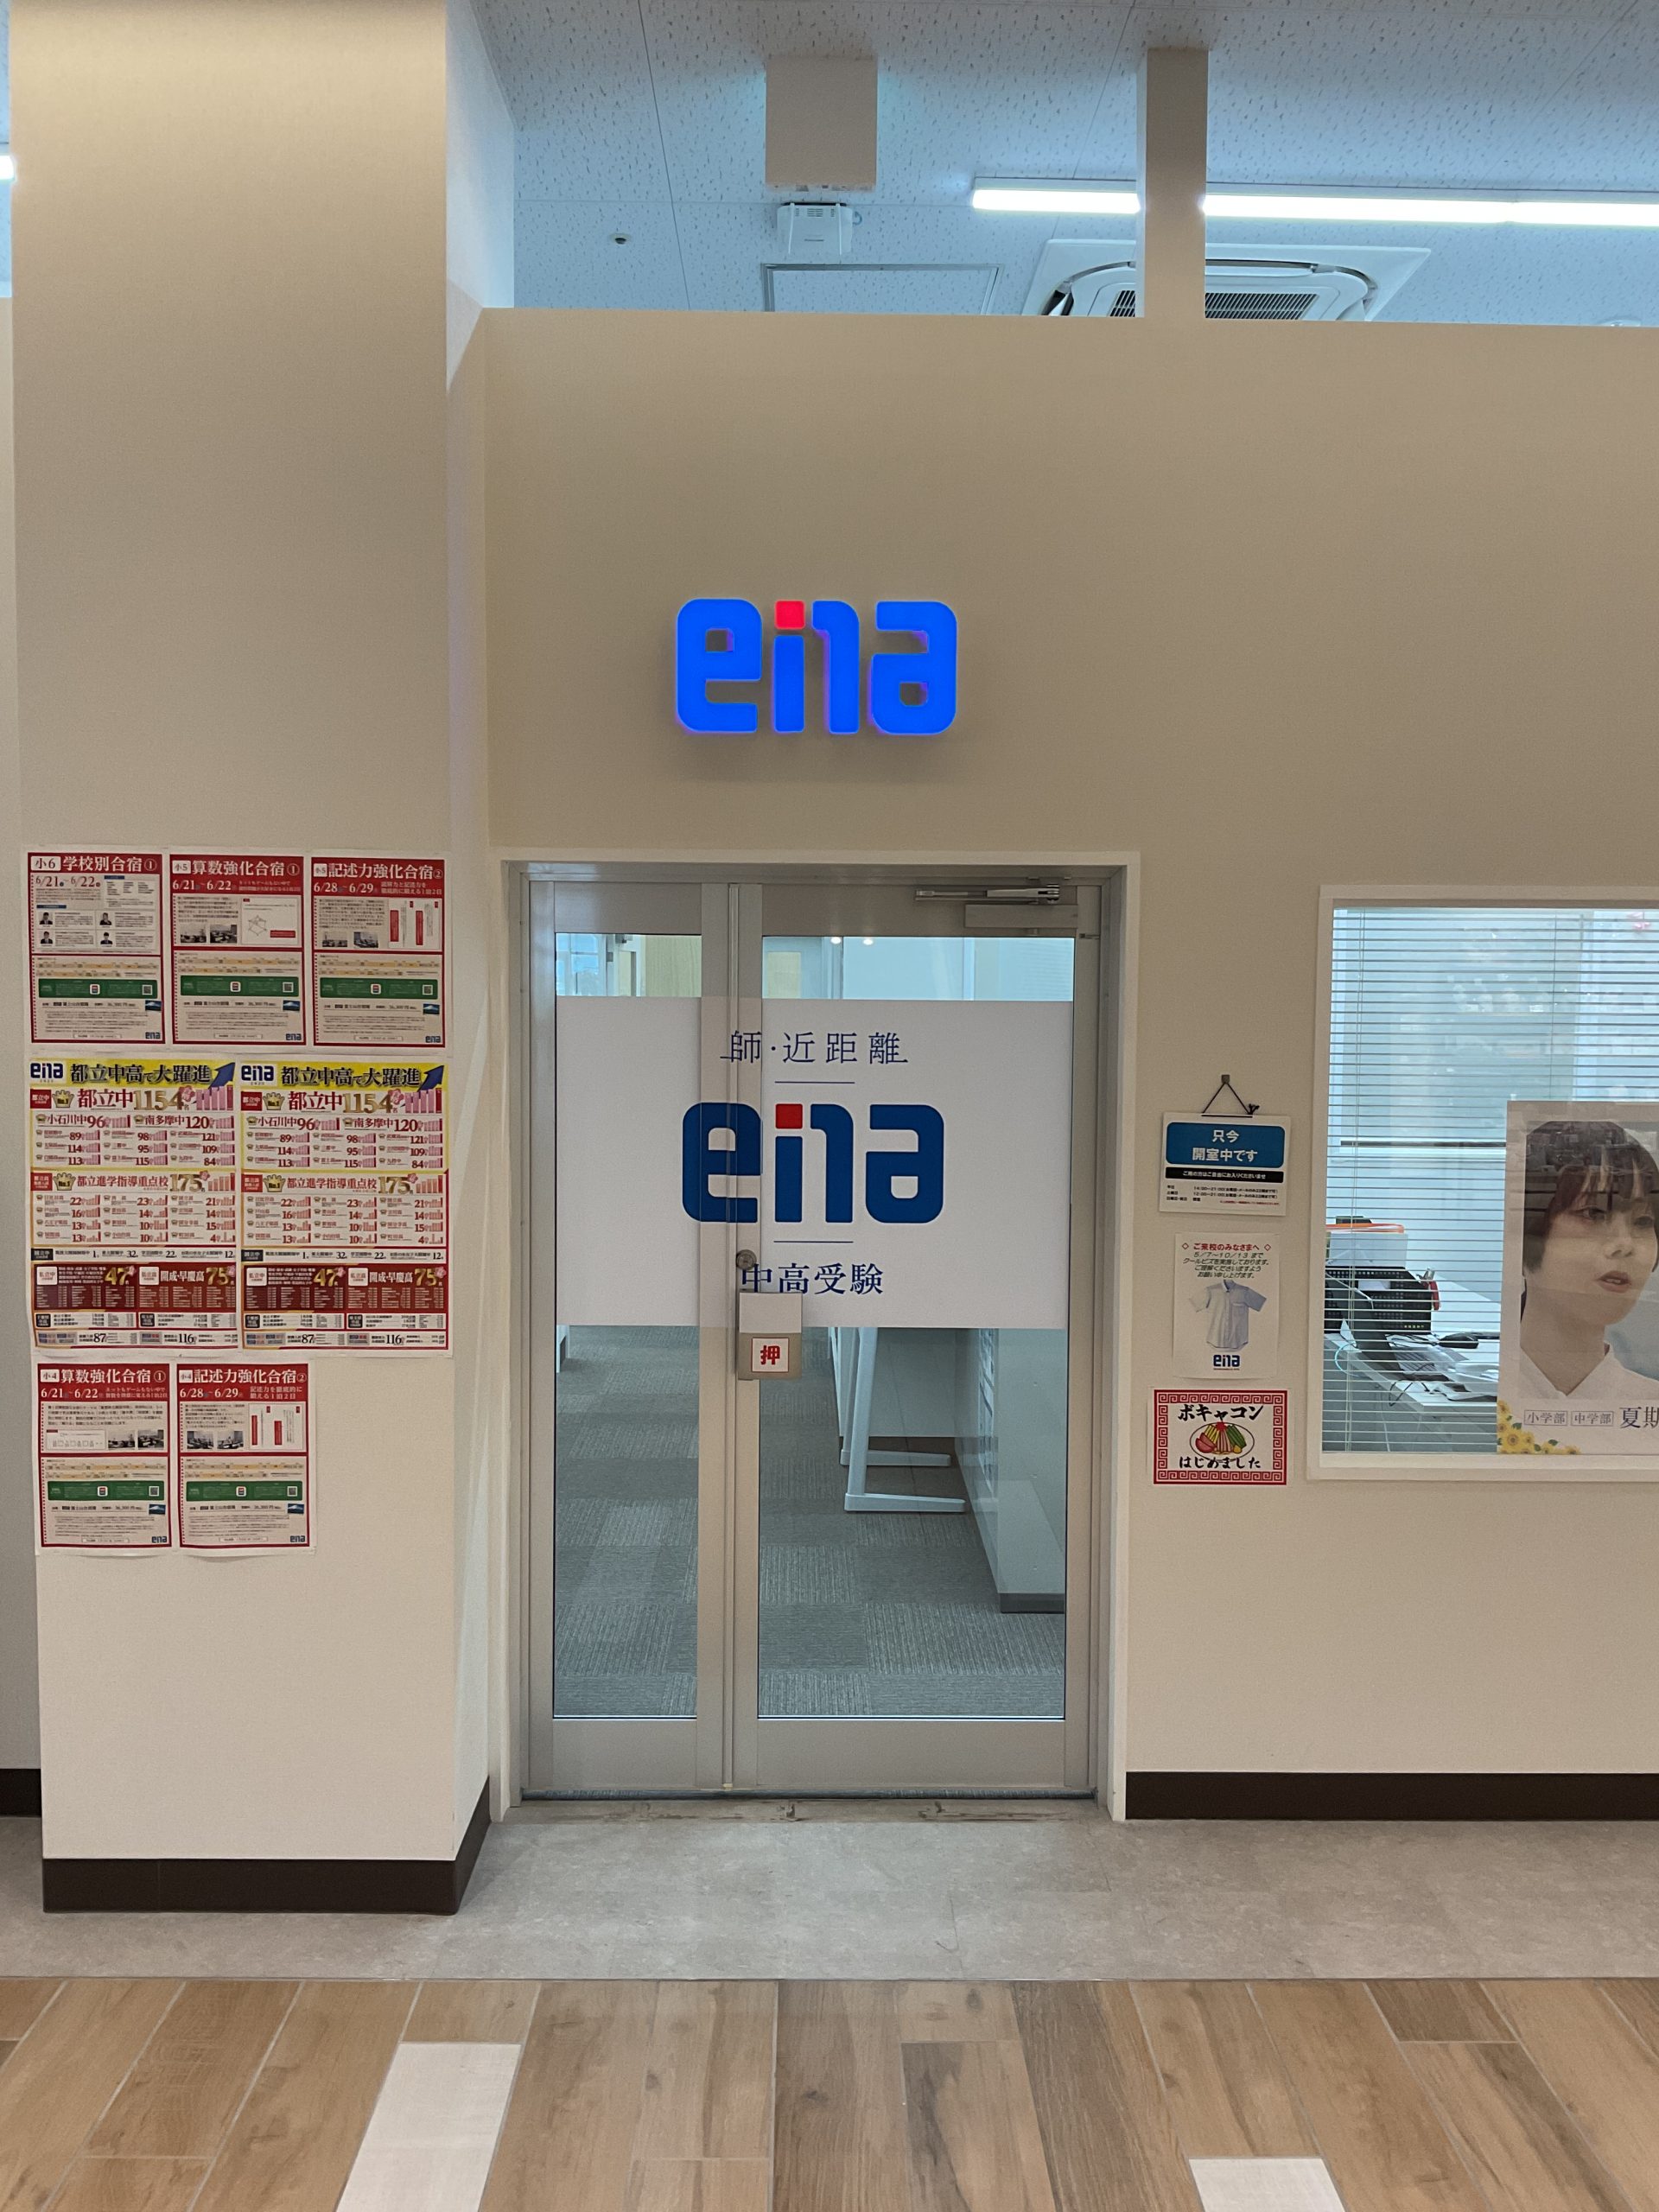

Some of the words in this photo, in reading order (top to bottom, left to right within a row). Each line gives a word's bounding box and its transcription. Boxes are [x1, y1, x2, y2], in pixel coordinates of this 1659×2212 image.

[677, 598, 957, 734] ena
[35, 858, 56, 869] 小6
[30, 1063, 64, 1078] ena
[241, 1065, 274, 1081] ena
[77, 1089, 133, 1108] 都立中
[288, 1090, 342, 1110] 都立中
[1211, 1129, 1240, 1142] 只今
[1192, 1147, 1258, 1162] 開室中です
[683, 1103, 944, 1224] ena
[1193, 1243, 1260, 1251] ご来校のみなさまへ
[741, 1262, 884, 1294] 中高受験
[760, 1345, 780, 1365] 押
[1213, 1354, 1241, 1367] ena
[1178, 1404, 1264, 1422] ボキャコン
[1527, 1412, 1566, 1424] 小学部
[1574, 1412, 1611, 1424] 中学部
[1179, 1456, 1262, 1469] はじめました
